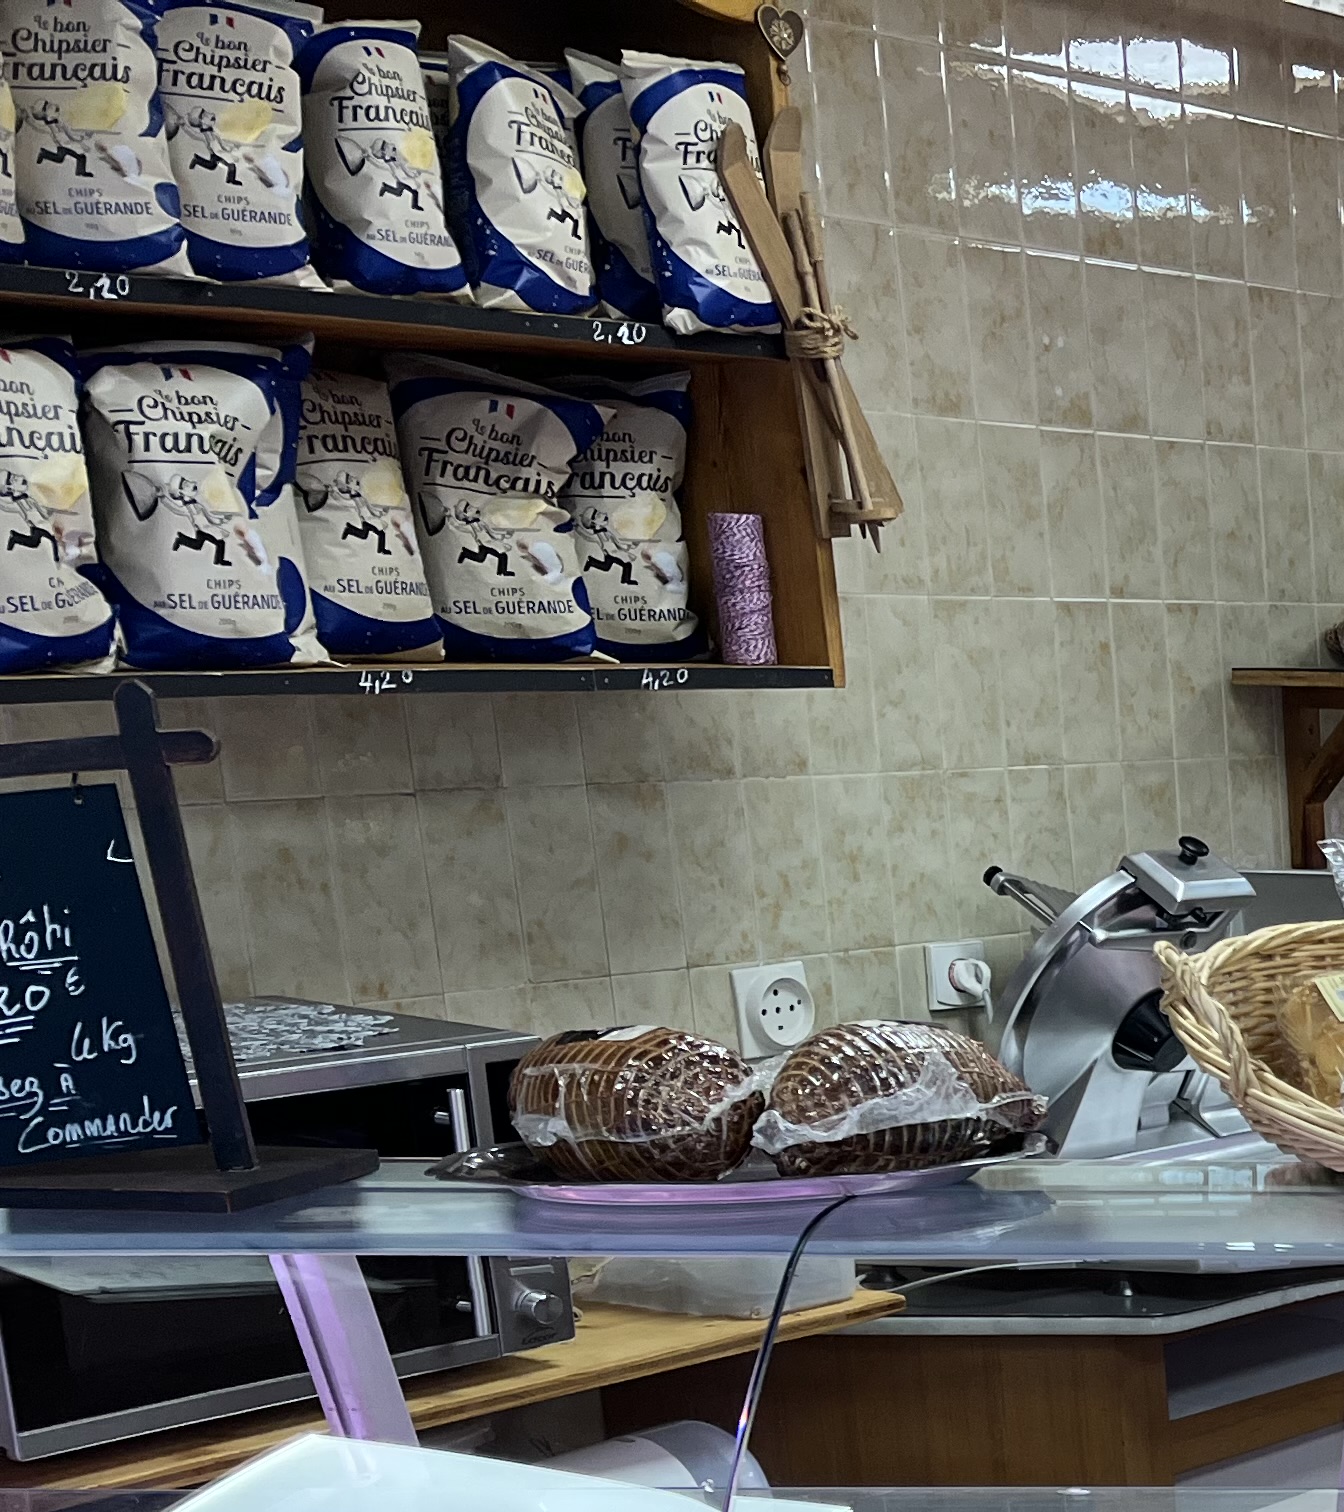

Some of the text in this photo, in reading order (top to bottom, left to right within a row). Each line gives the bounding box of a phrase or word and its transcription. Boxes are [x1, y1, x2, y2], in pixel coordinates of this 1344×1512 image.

[53, 16, 90, 33] bon
[11, 27, 112, 60] Chipsier
[215, 33, 249, 52] bon
[173, 40, 272, 73] Chipsier
[157, 58, 285, 104] Français
[351, 72, 418, 103] Chipsier
[330, 96, 431, 130] Françai
[67, 187, 103, 198] CHIPS
[217, 194, 250, 205] CHIPS
[35, 202, 59, 216] SEL
[74, 198, 153, 216] GUÉRANDE
[183, 203, 293, 226] SEL GUÉRANDE
[376, 229, 454, 248] SEL GUÉRAN
[714, 264, 733, 277] SEL
[176, 390, 218, 406] bon
[137, 395, 239, 431] Chipsier
[300, 399, 382, 428] Chipsier
[486, 424, 523, 446] bon
[299, 429, 399, 462] rançai
[445, 427, 537, 468] Chipsier
[417, 447, 556, 498] Français
[566, 468, 672, 497] rançais
[371, 566, 400, 577] CHIPS
[207, 578, 241, 589] CHIPS
[336, 579, 363, 594] SEL
[374, 575, 430, 597] GUÉRAND
[490, 587, 525, 597] CHIPS
[6, 595, 41, 614] SEL
[166, 594, 196, 610] SEL
[210, 590, 283, 610] GUÉRANDE
[453, 601, 481, 615] SEL
[495, 598, 574, 615] GUÉRANDE
[613, 595, 648, 605] CHIPS
[590, 607, 604, 620] EL
[358, 671, 414, 694] 4,20
[642, 669, 688, 690] 4,20
